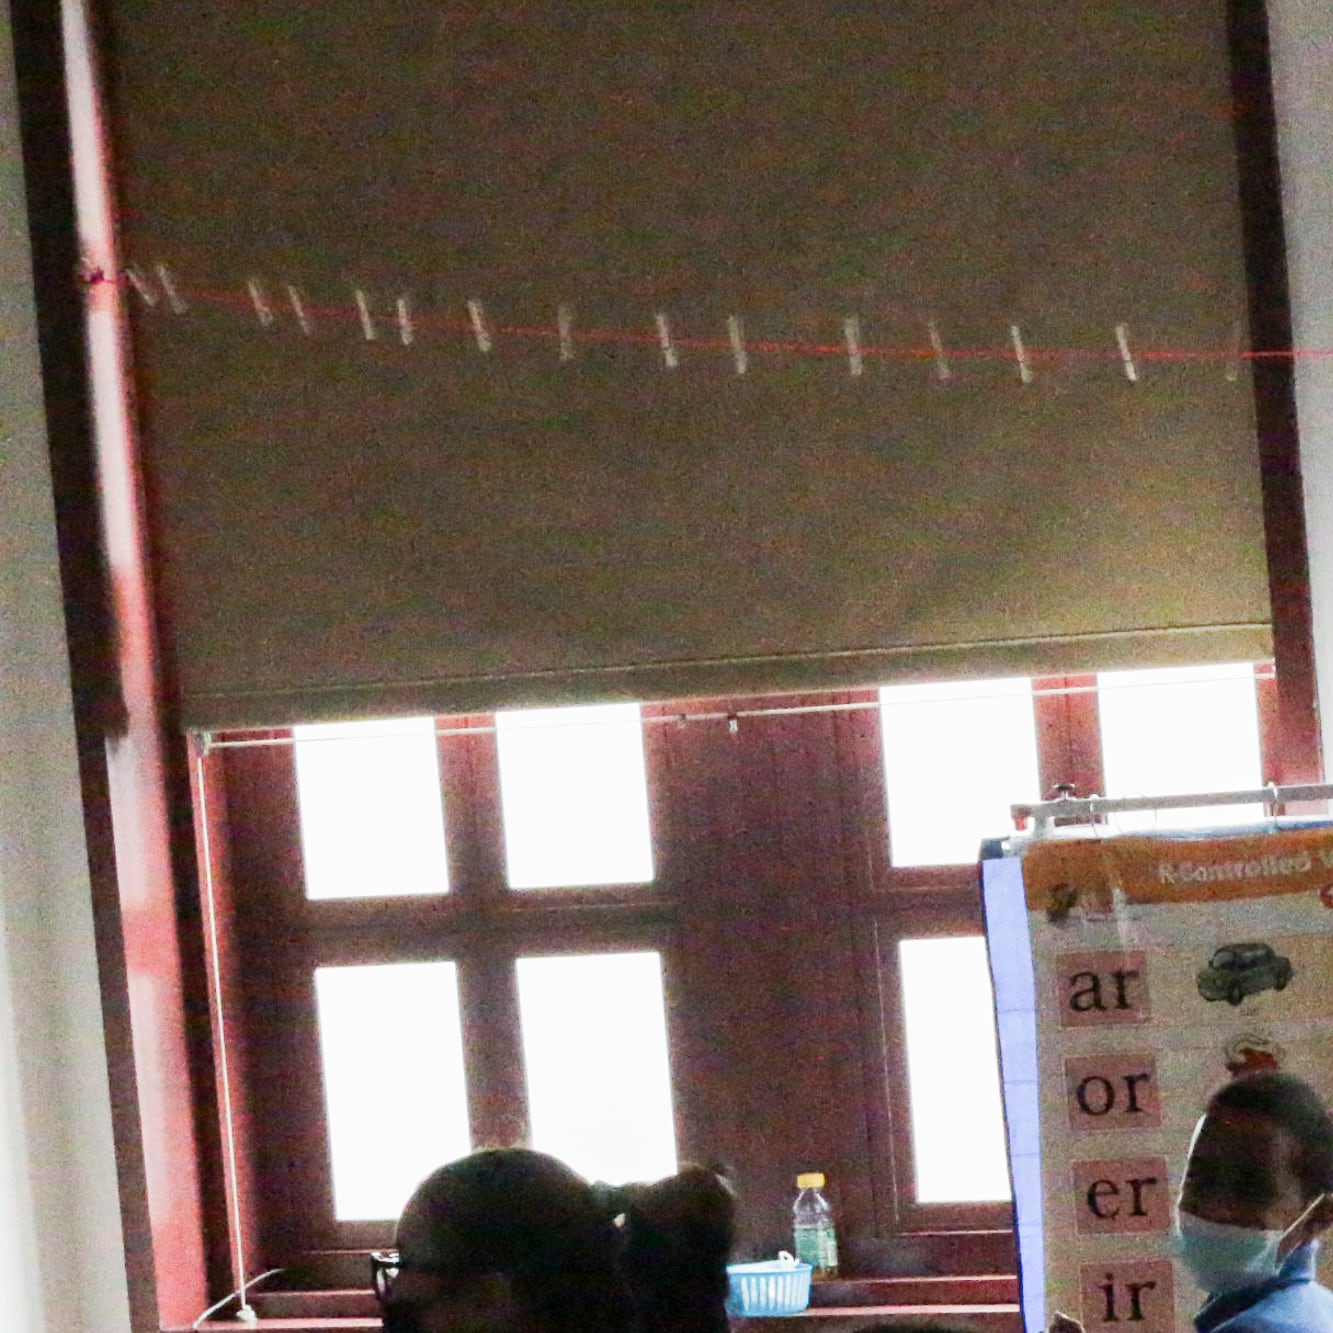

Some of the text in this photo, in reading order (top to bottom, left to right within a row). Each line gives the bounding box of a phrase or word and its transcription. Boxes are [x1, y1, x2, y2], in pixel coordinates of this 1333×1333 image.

[1068, 970, 1139, 1012] ar
[1076, 1073, 1150, 1116] or
[1087, 1177, 1158, 1219] er
[1097, 1271, 1157, 1322] ir
